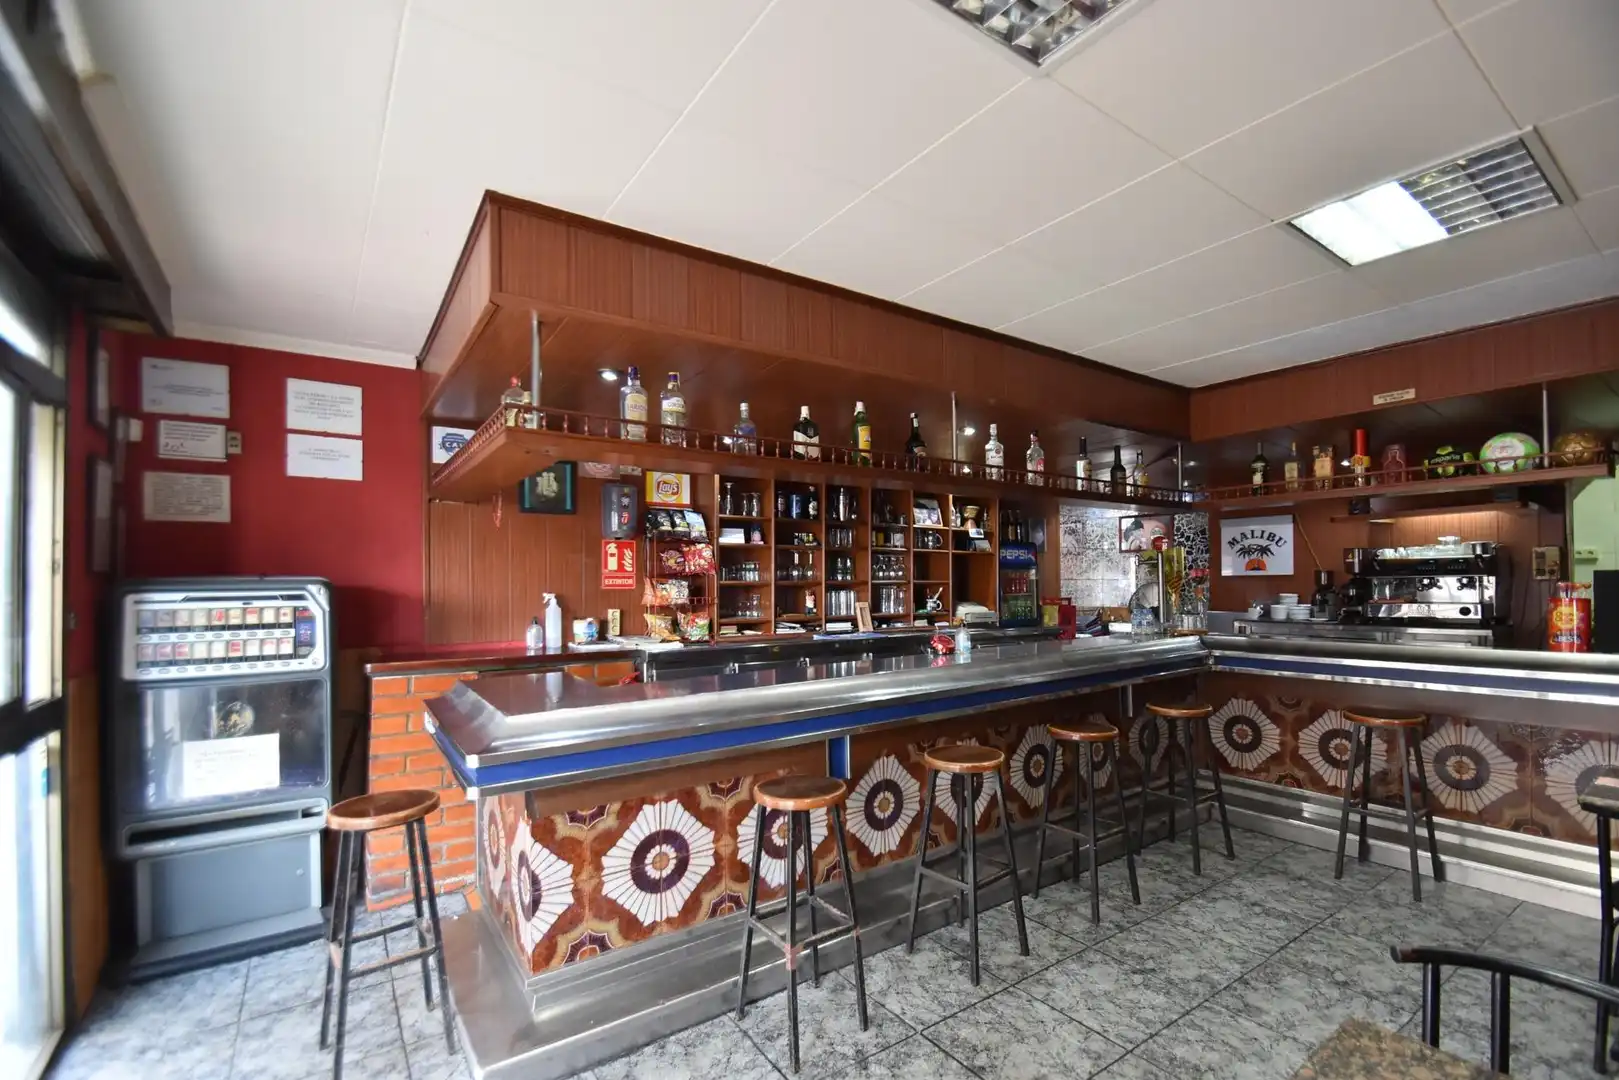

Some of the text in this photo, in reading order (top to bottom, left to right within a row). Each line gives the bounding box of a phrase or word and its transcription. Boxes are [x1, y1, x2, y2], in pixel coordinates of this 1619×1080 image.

[658, 480, 680, 496] Lay's
[1227, 529, 1288, 551] MALIBU
[1000, 549, 1028, 560] PEPSI
